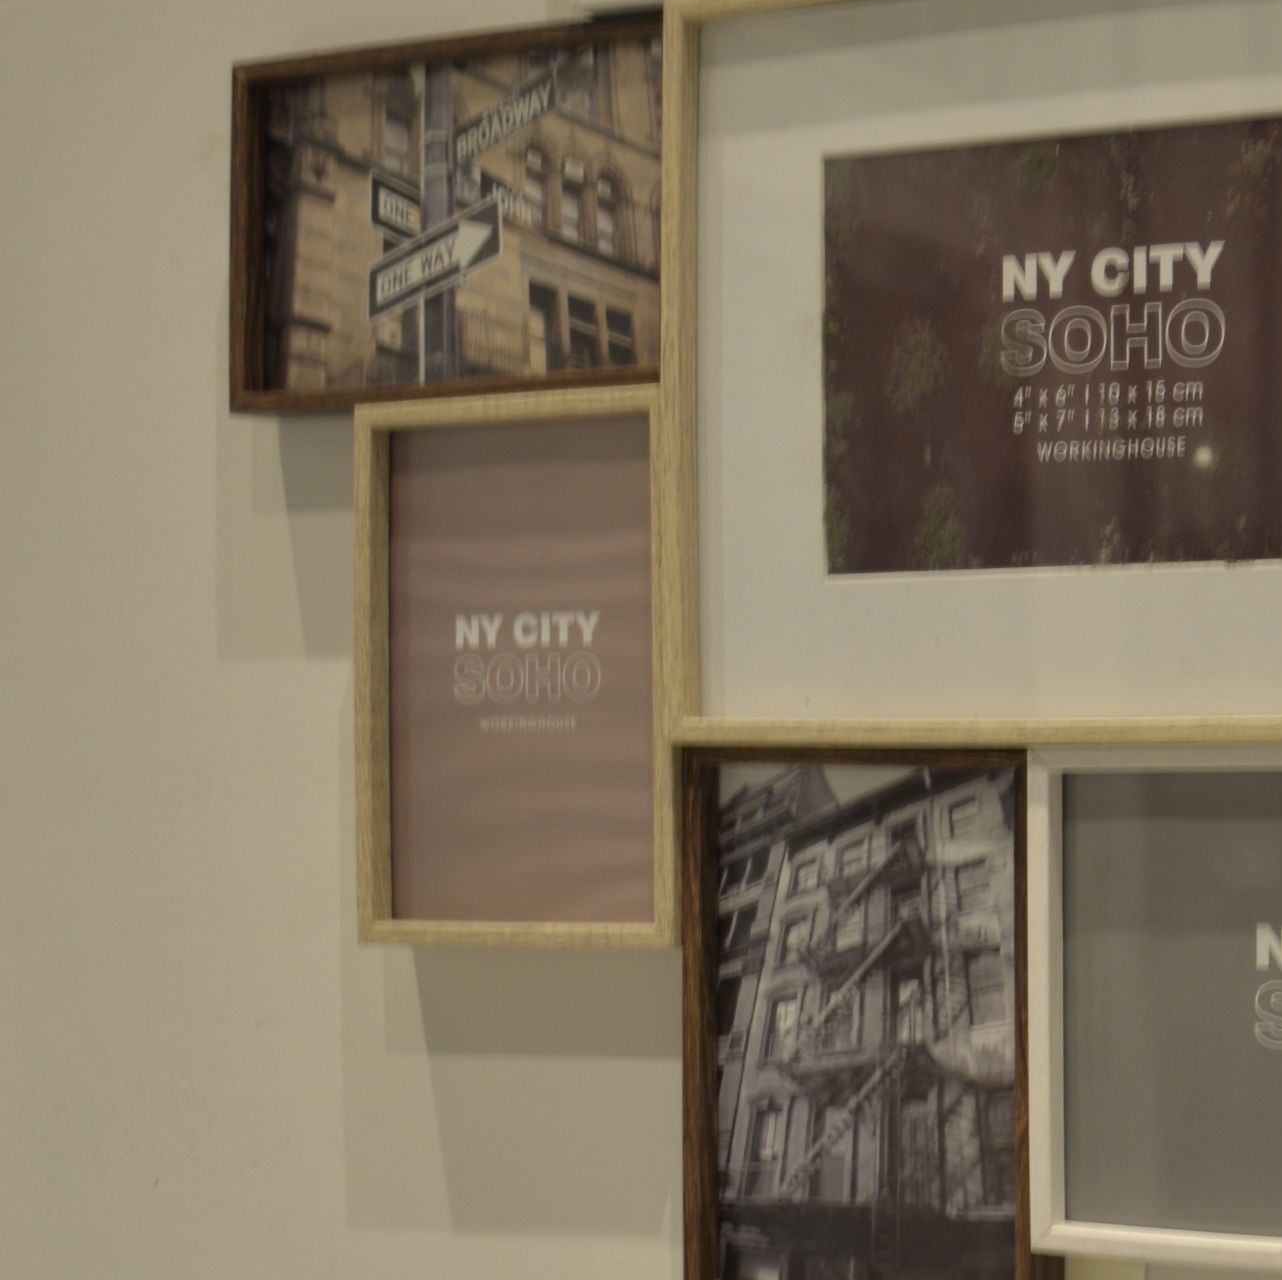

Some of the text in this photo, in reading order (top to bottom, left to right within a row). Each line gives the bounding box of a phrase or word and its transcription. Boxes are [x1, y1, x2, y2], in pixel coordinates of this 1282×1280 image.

[457, 80, 551, 166] BROADWAY
[421, 234, 458, 276] WAY
[1002, 240, 1226, 303] NY CITY
[1000, 298, 1226, 377] SOHO
[1099, 382, 1120, 406] 10
[1172, 381, 1204, 402] cm
[1172, 406, 1204, 427] cm
[1037, 435, 1186, 464] WORKINGHOUSE
[455, 609, 600, 651] NY CITY
[454, 651, 601, 707] SOHO
